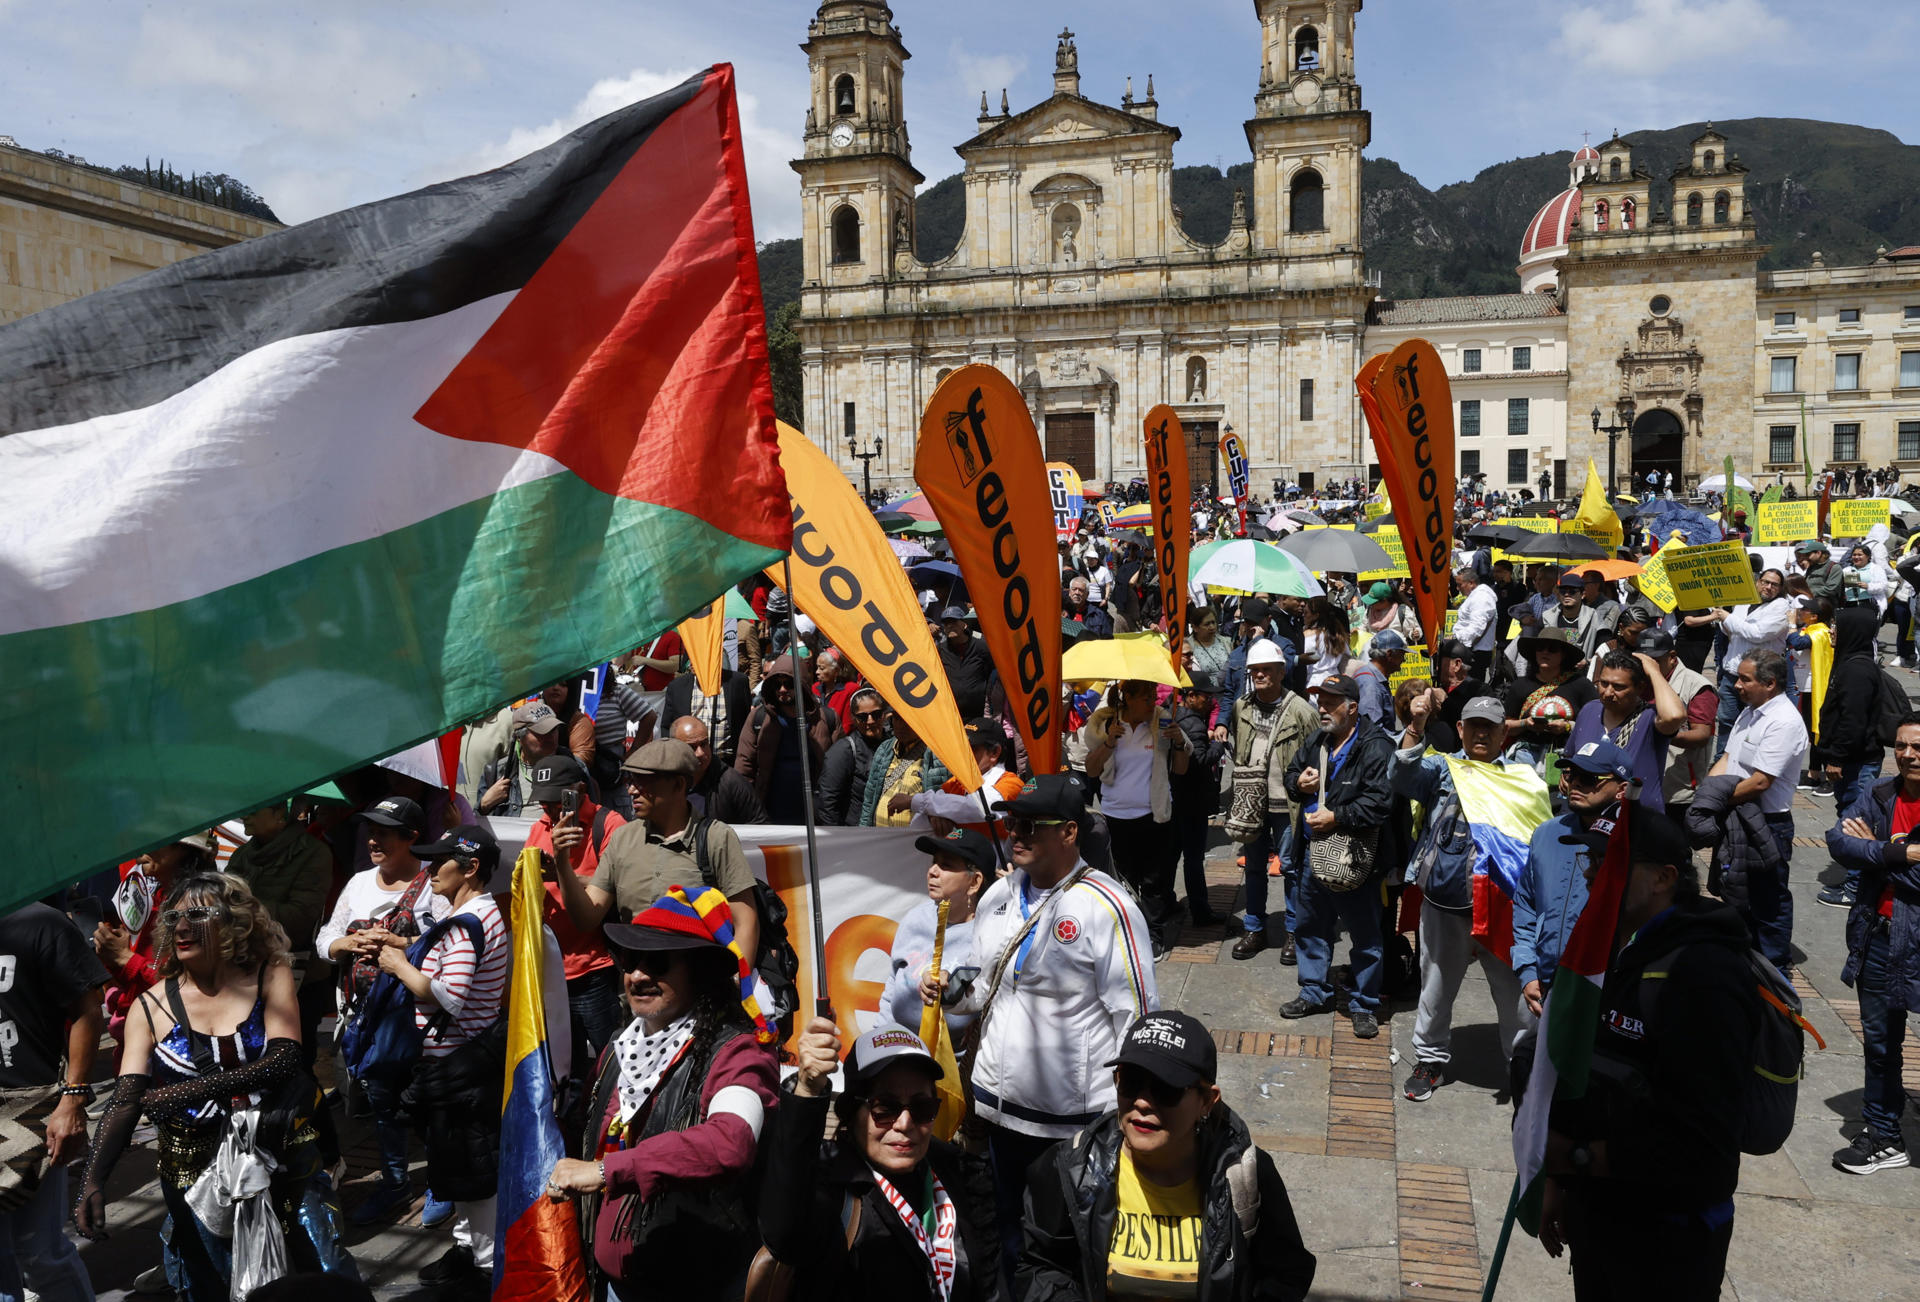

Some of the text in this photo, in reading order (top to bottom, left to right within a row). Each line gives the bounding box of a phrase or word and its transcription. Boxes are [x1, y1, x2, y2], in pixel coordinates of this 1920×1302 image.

[1226, 437, 1247, 497] CUT
[1406, 352, 1447, 574] fecode
[1050, 469, 1069, 529] CUT
[1844, 501, 1881, 509] APOYAMOS
[1767, 503, 1809, 511] APOYAMOS
[1775, 509, 1813, 517] CONSULTA
[1838, 508, 1888, 517] LAS REFORMAS
[1778, 522, 1815, 530] GOBIERNO
[1782, 529, 1811, 537] CAMBIO
[967, 387, 1050, 740] fecode
[1709, 553, 1742, 565] INTEGRAL
[1691, 566, 1724, 579] PARA LA
[790, 494, 938, 709] code
